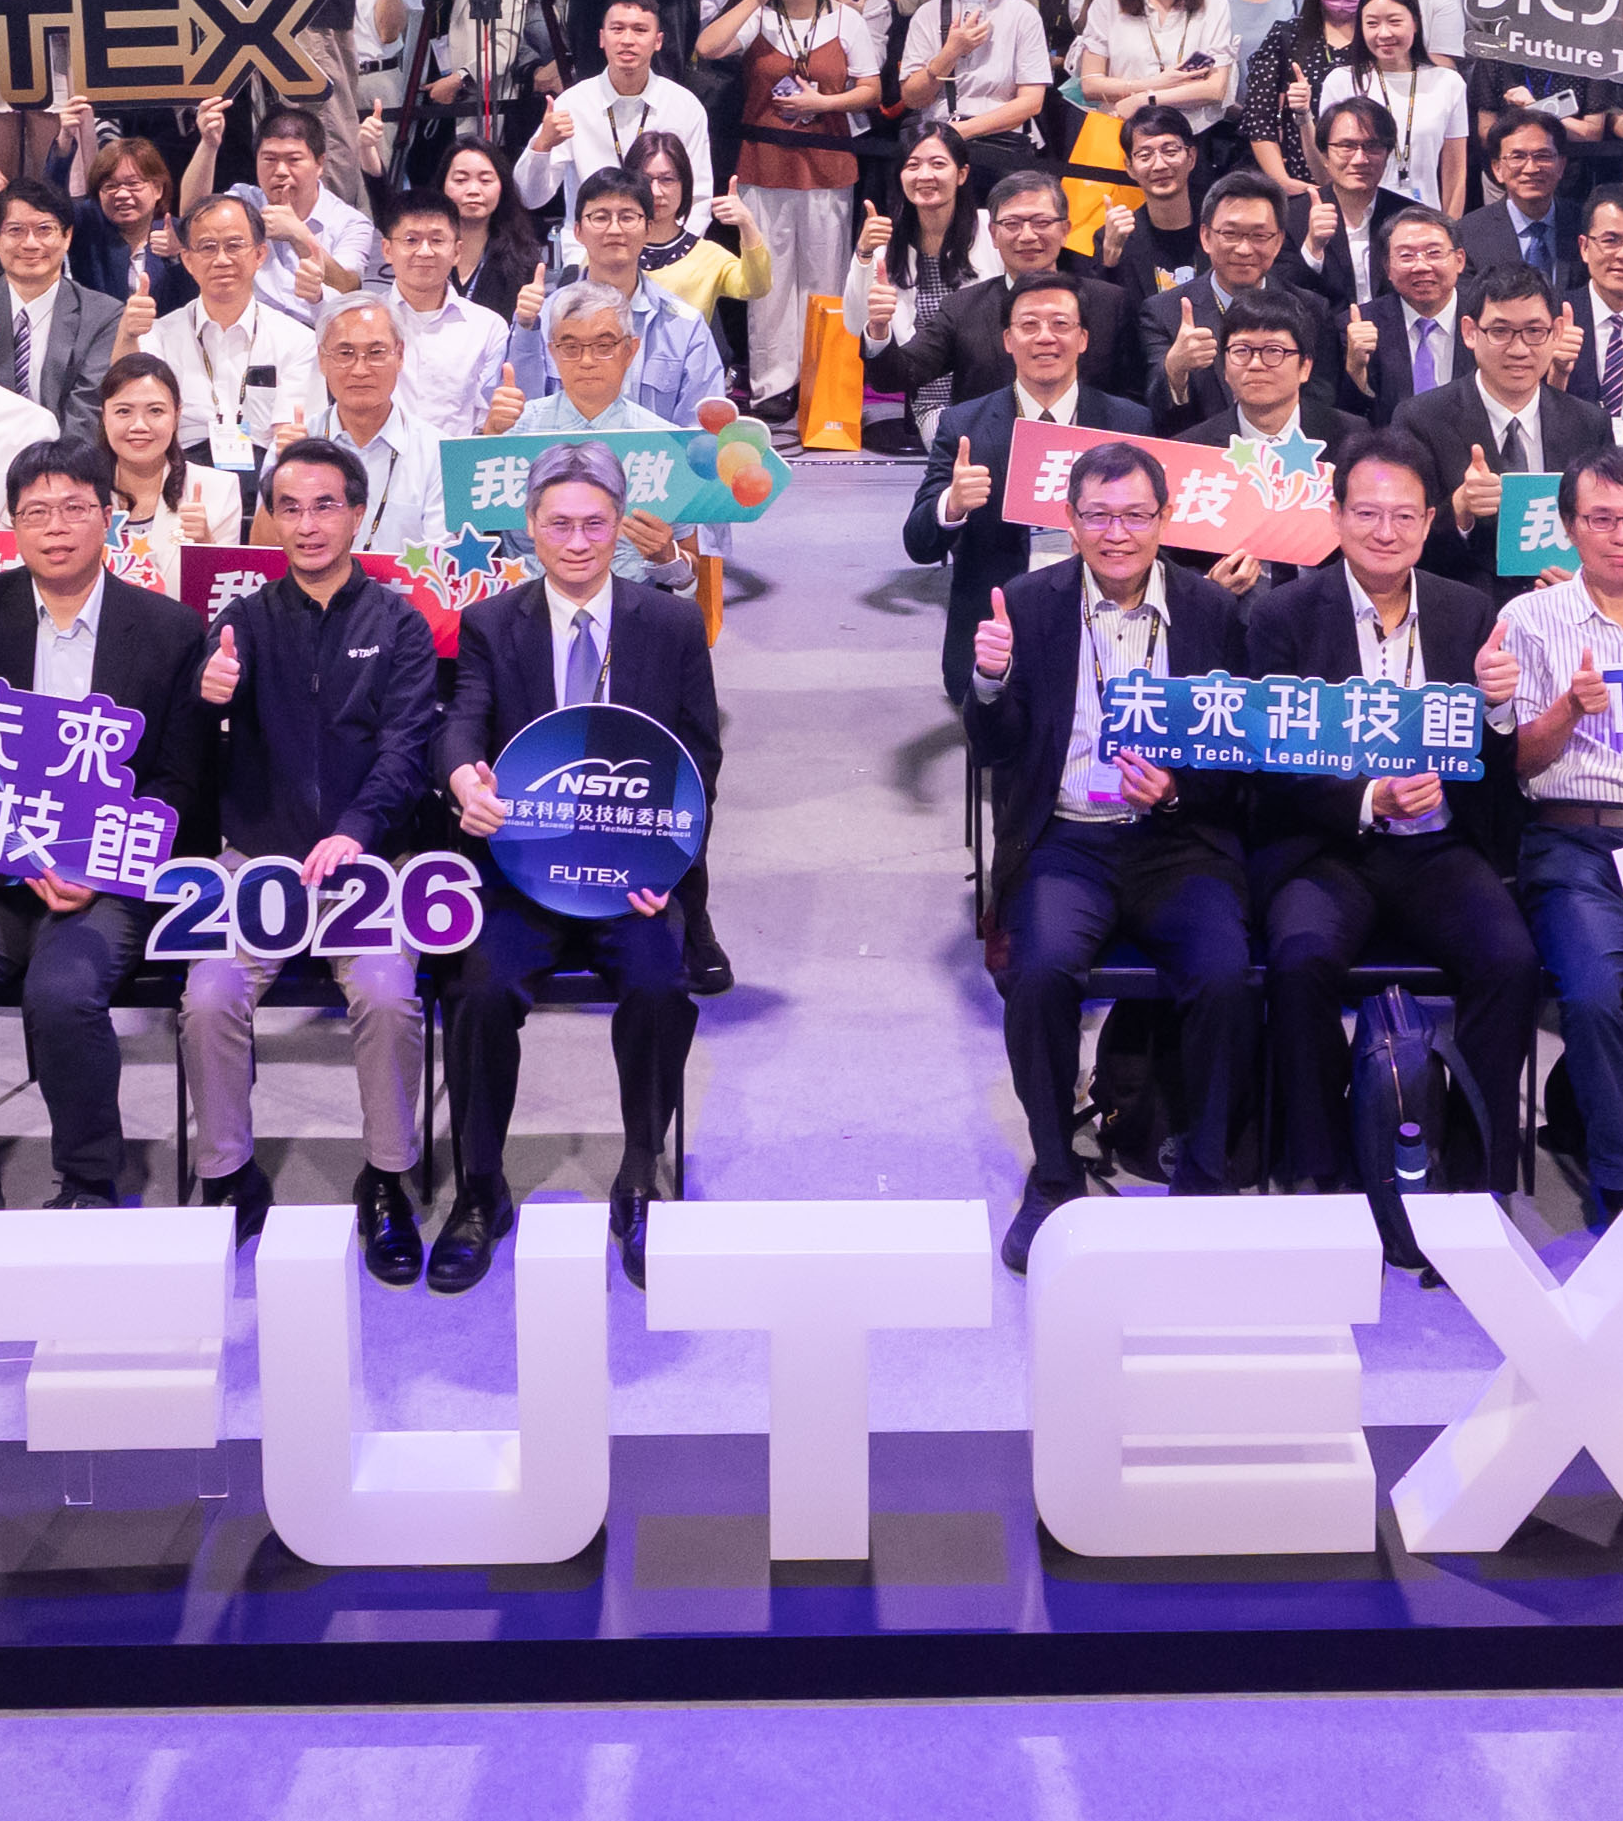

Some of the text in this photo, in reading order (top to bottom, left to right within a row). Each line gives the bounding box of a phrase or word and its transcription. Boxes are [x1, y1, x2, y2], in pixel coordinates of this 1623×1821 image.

[1507, 30, 1605, 70] Future
[1107, 678, 1478, 748] 未來科技館
[1193, 744, 1253, 766] Tech,
[1265, 749, 1354, 771] Leading
[1364, 753, 1417, 773] Your
[1427, 754, 1477, 775] Life.
[556, 772, 652, 803] NSTC
[497, 796, 695, 832] 國家科學及技術委員會
[536, 820, 692, 840] Science and Technology Council
[527, 864, 630, 884] FUTEX
[148, 854, 482, 959] 2026
